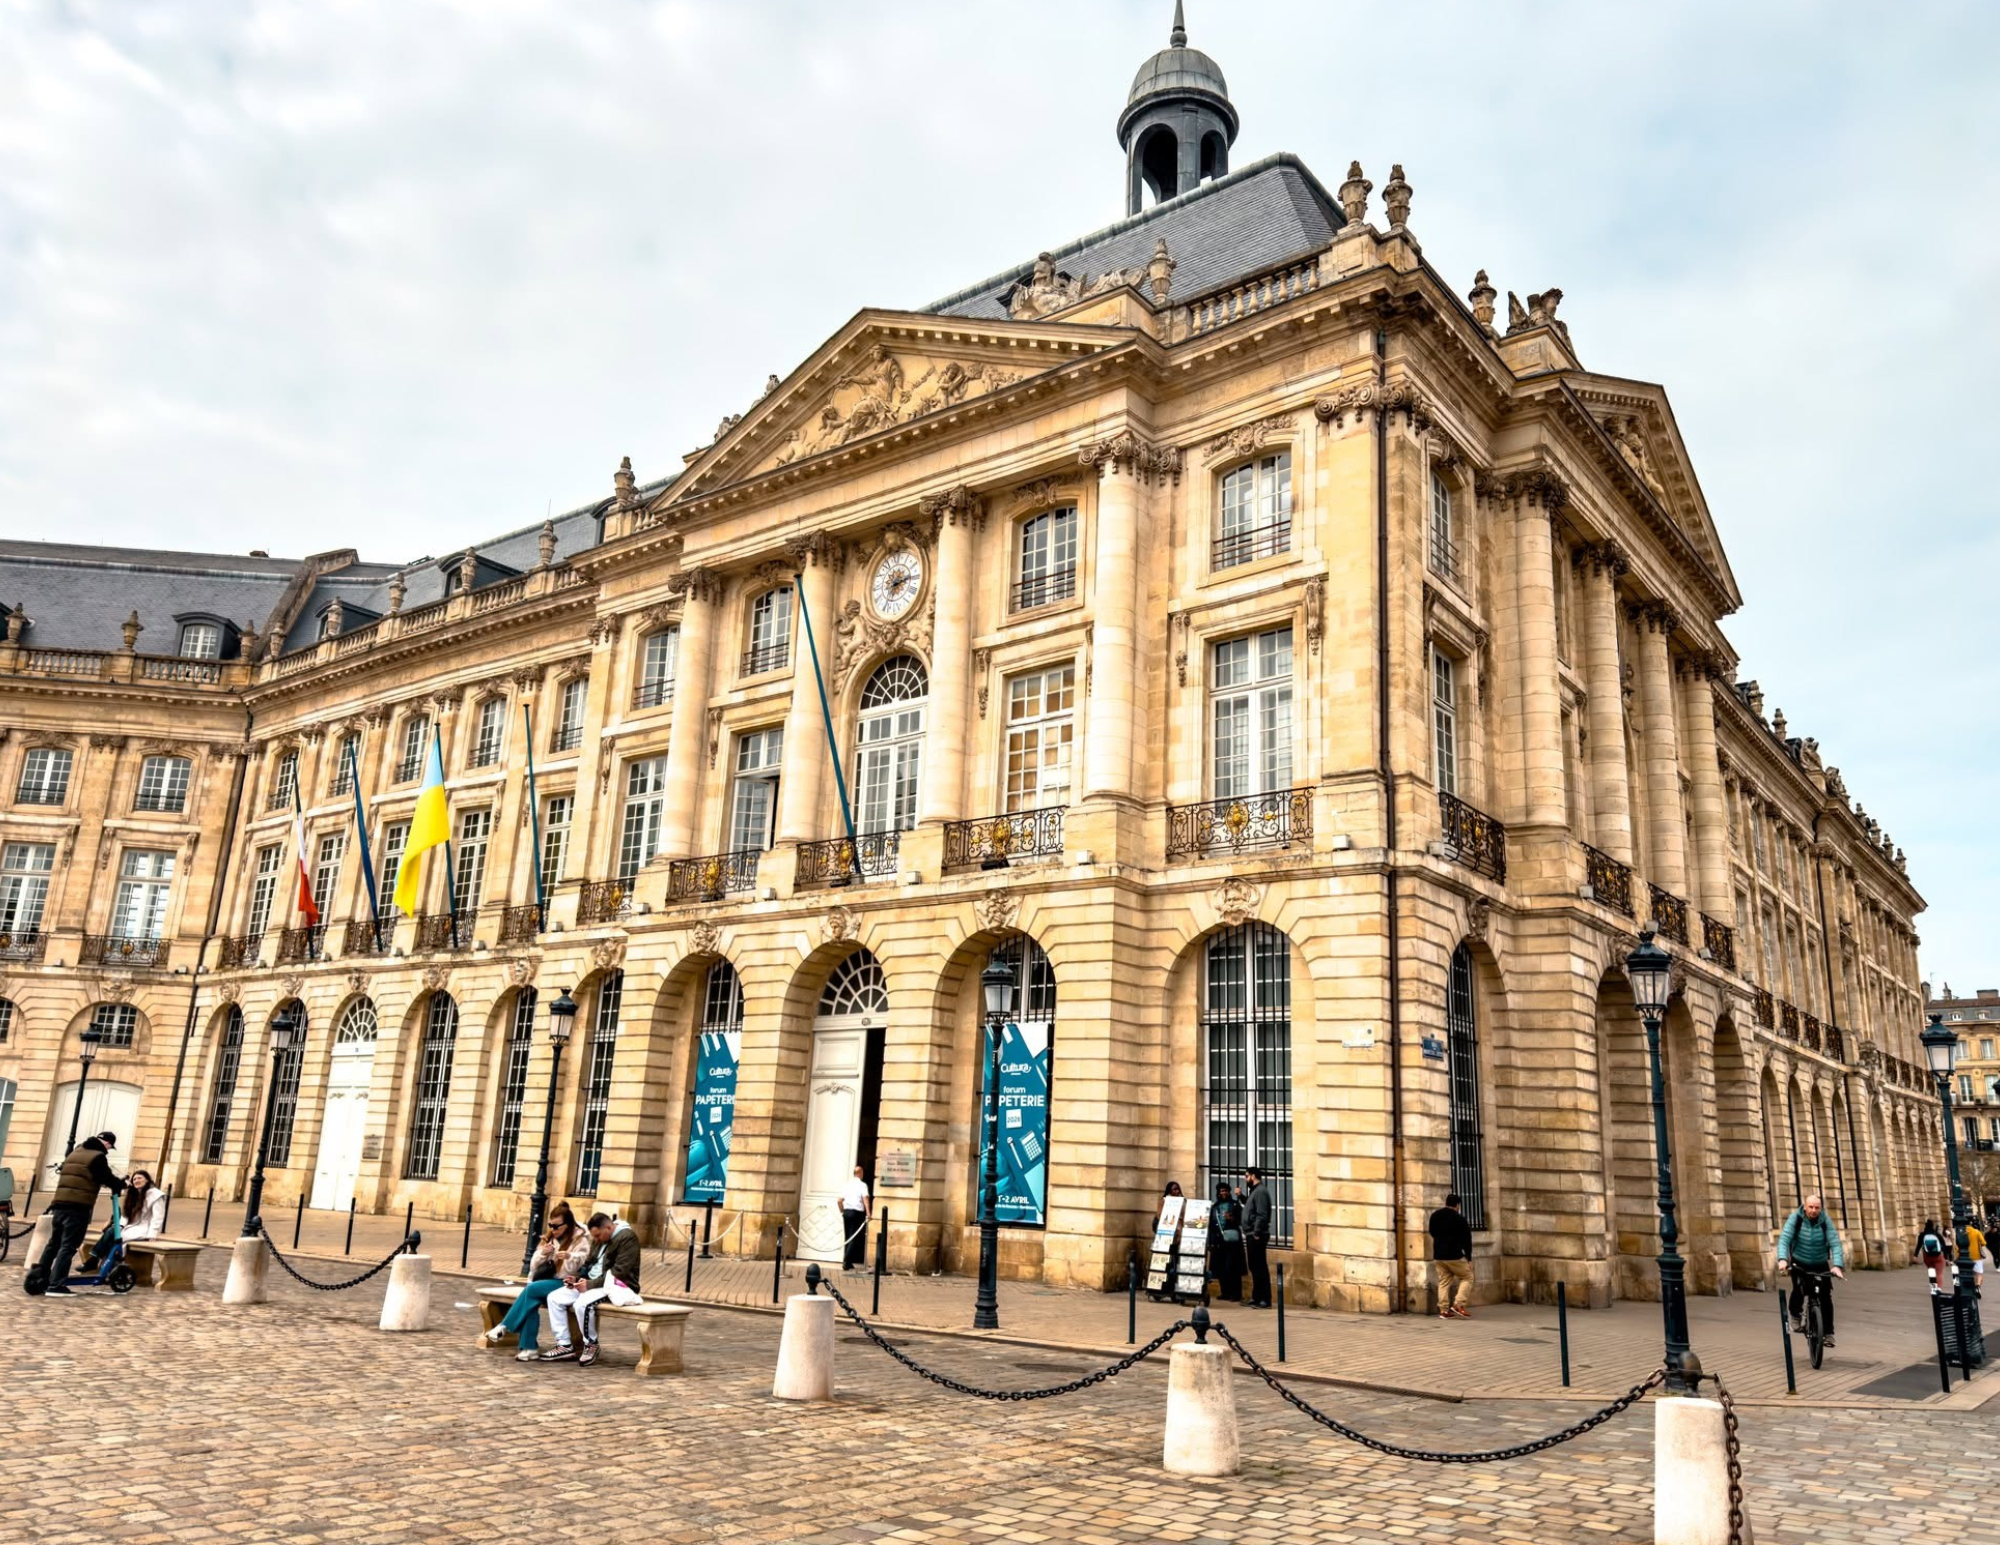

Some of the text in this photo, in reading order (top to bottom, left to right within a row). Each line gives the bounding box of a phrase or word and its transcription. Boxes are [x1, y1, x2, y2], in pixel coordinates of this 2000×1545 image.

[1000, 1062, 1032, 1073] Cultura
[1003, 1086, 1026, 1094] forum
[695, 1094, 736, 1105] PAPETERI
[985, 1094, 1045, 1107] PPETERIE
[1010, 1195, 1030, 1204] AVRIL
